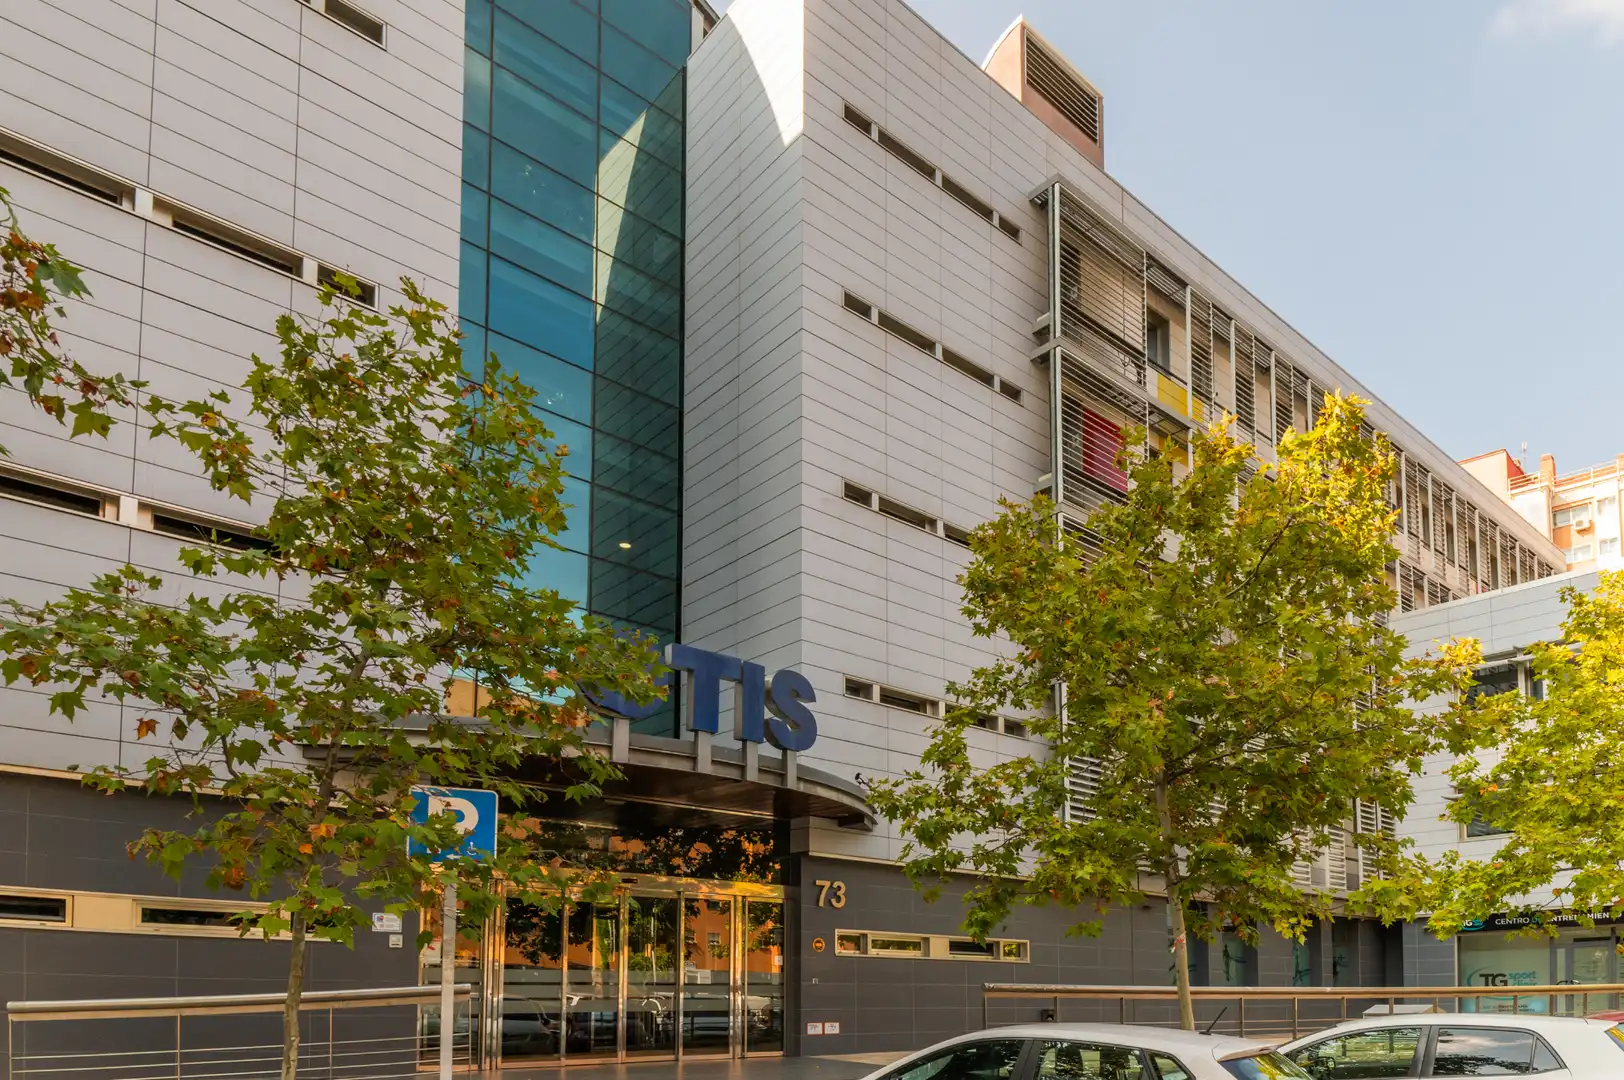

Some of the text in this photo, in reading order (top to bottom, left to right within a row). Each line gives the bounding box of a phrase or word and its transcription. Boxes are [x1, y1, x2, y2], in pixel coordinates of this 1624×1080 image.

[815, 880, 847, 909] 73
[1495, 917, 1530, 925] CENTRO
[1479, 973, 1508, 986] TG
[1508, 970, 1537, 981] sport
